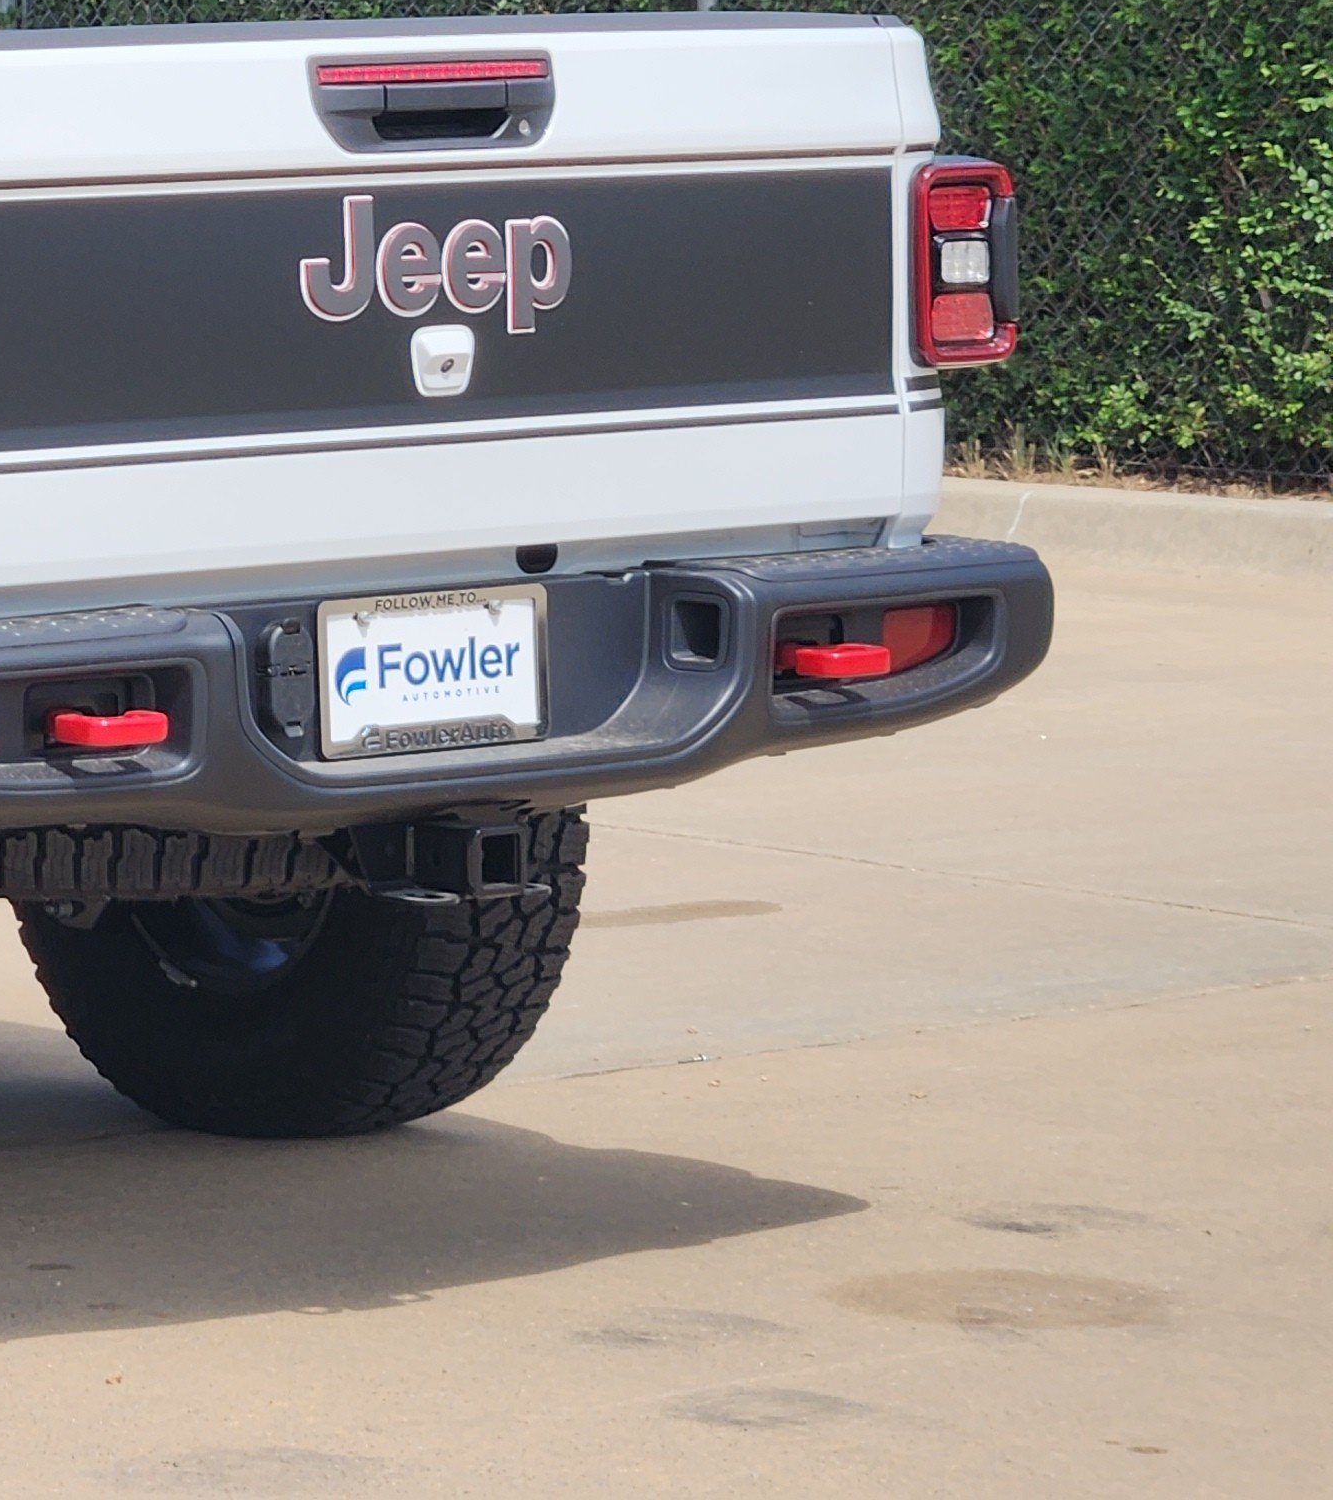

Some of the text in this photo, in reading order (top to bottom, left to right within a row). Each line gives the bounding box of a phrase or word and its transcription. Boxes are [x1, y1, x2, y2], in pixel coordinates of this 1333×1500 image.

[299, 194, 572, 335] Jeep
[375, 594, 433, 612] FOLLOW
[437, 594, 454, 606] ME
[377, 636, 521, 689] Fowler
[402, 686, 500, 702] AUTOMOTIVE
[385, 722, 512, 750] FowlerAuto
